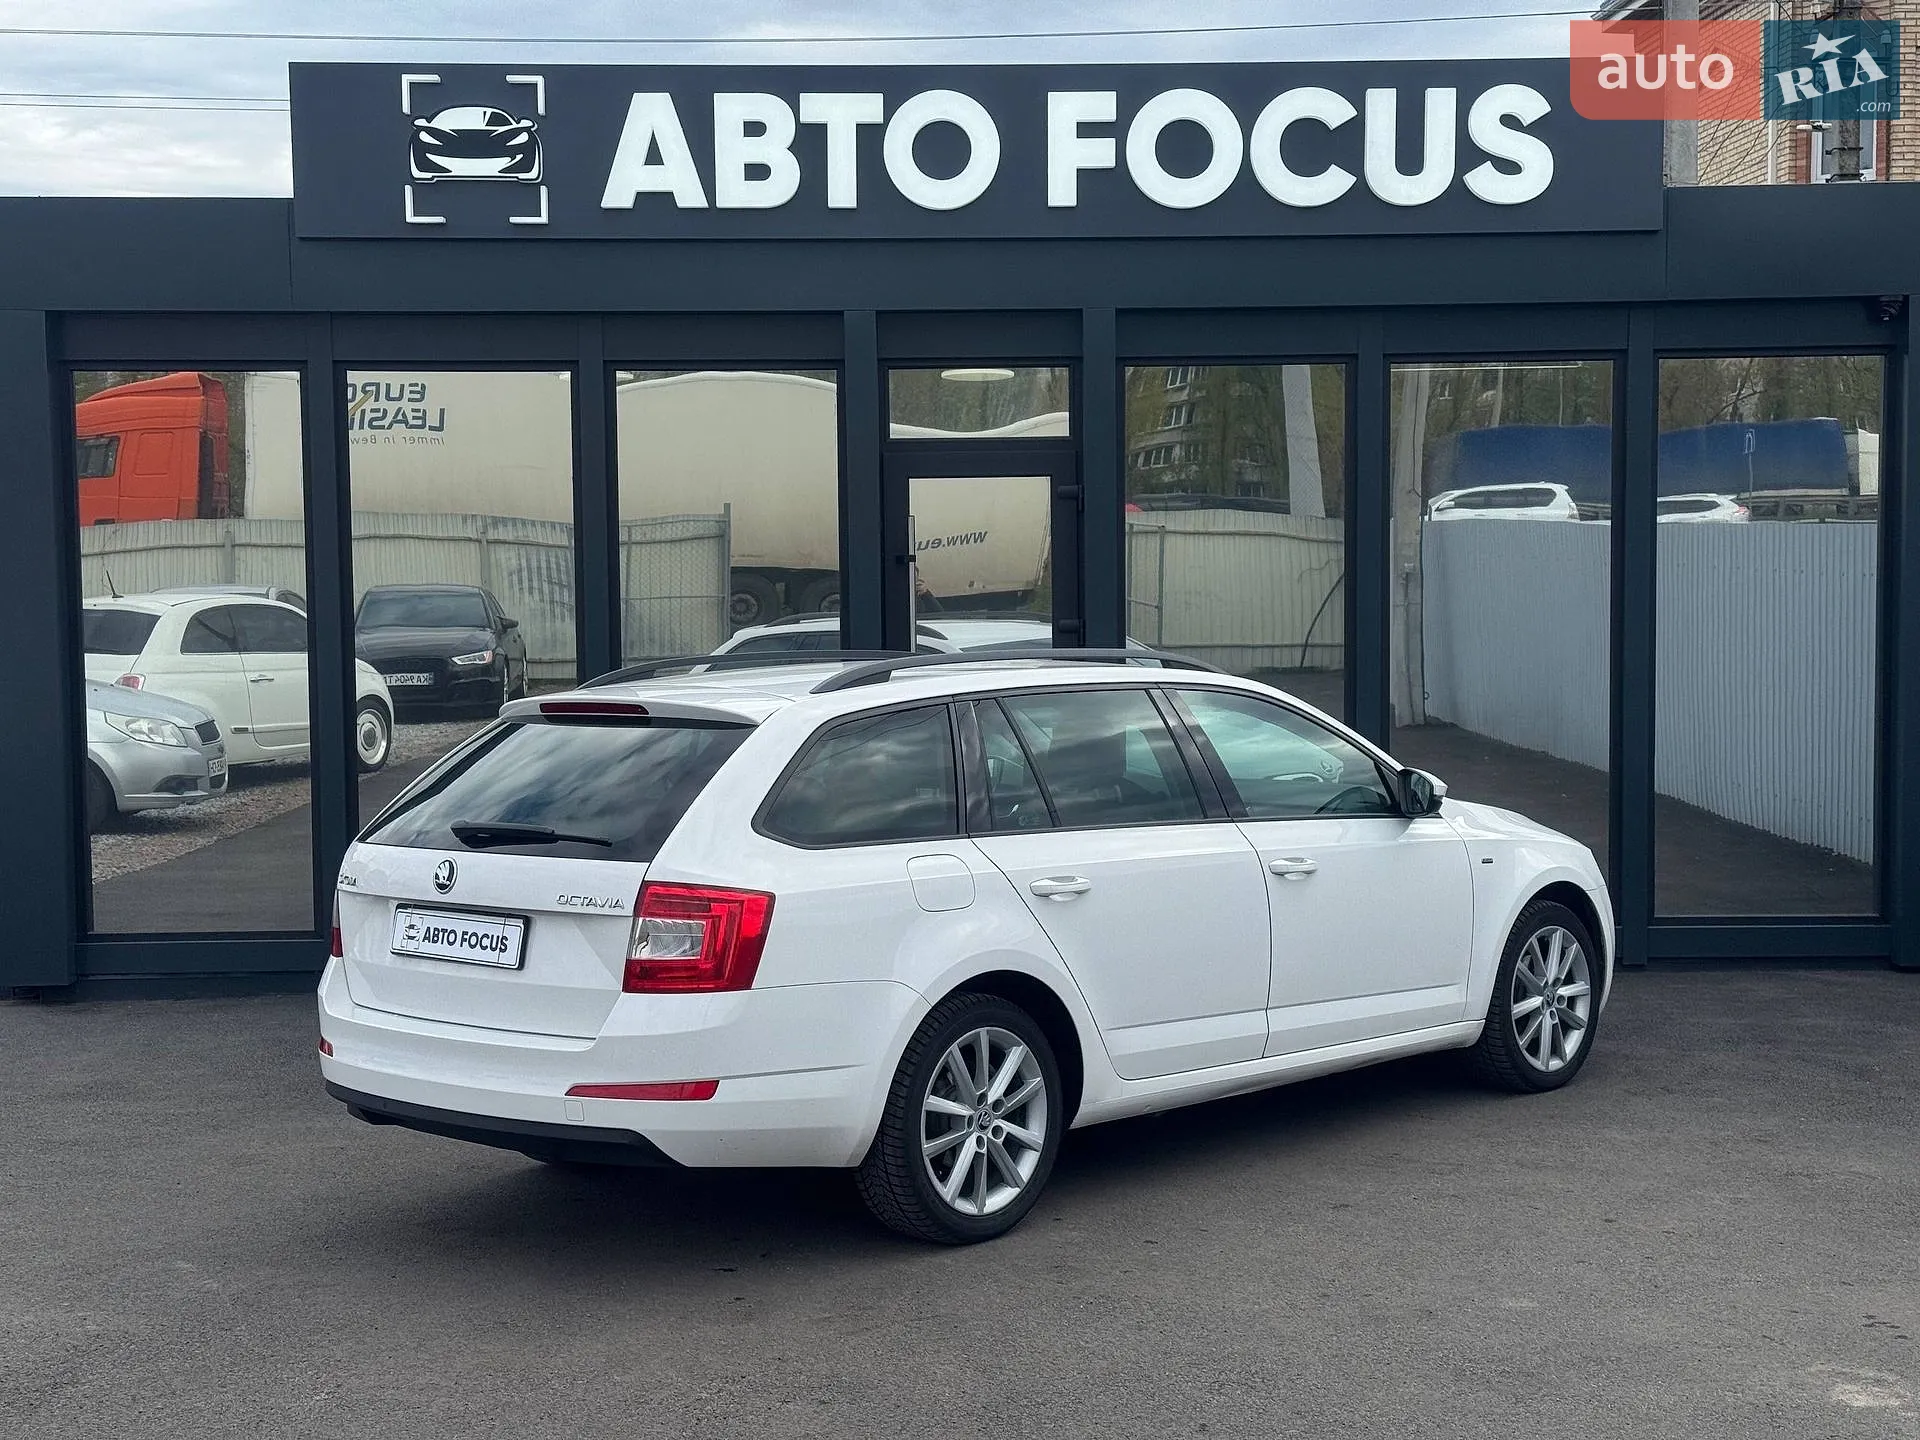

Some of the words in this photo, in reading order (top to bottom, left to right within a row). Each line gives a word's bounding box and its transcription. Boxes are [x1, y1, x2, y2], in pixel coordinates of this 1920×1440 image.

[600, 89, 1001, 211] АВТО
[1047, 83, 1555, 209] FOCUS
[557, 894, 625, 910] OCTAVIA
[422, 926, 458, 946] АВТО
[460, 930, 509, 953] FOCUS
